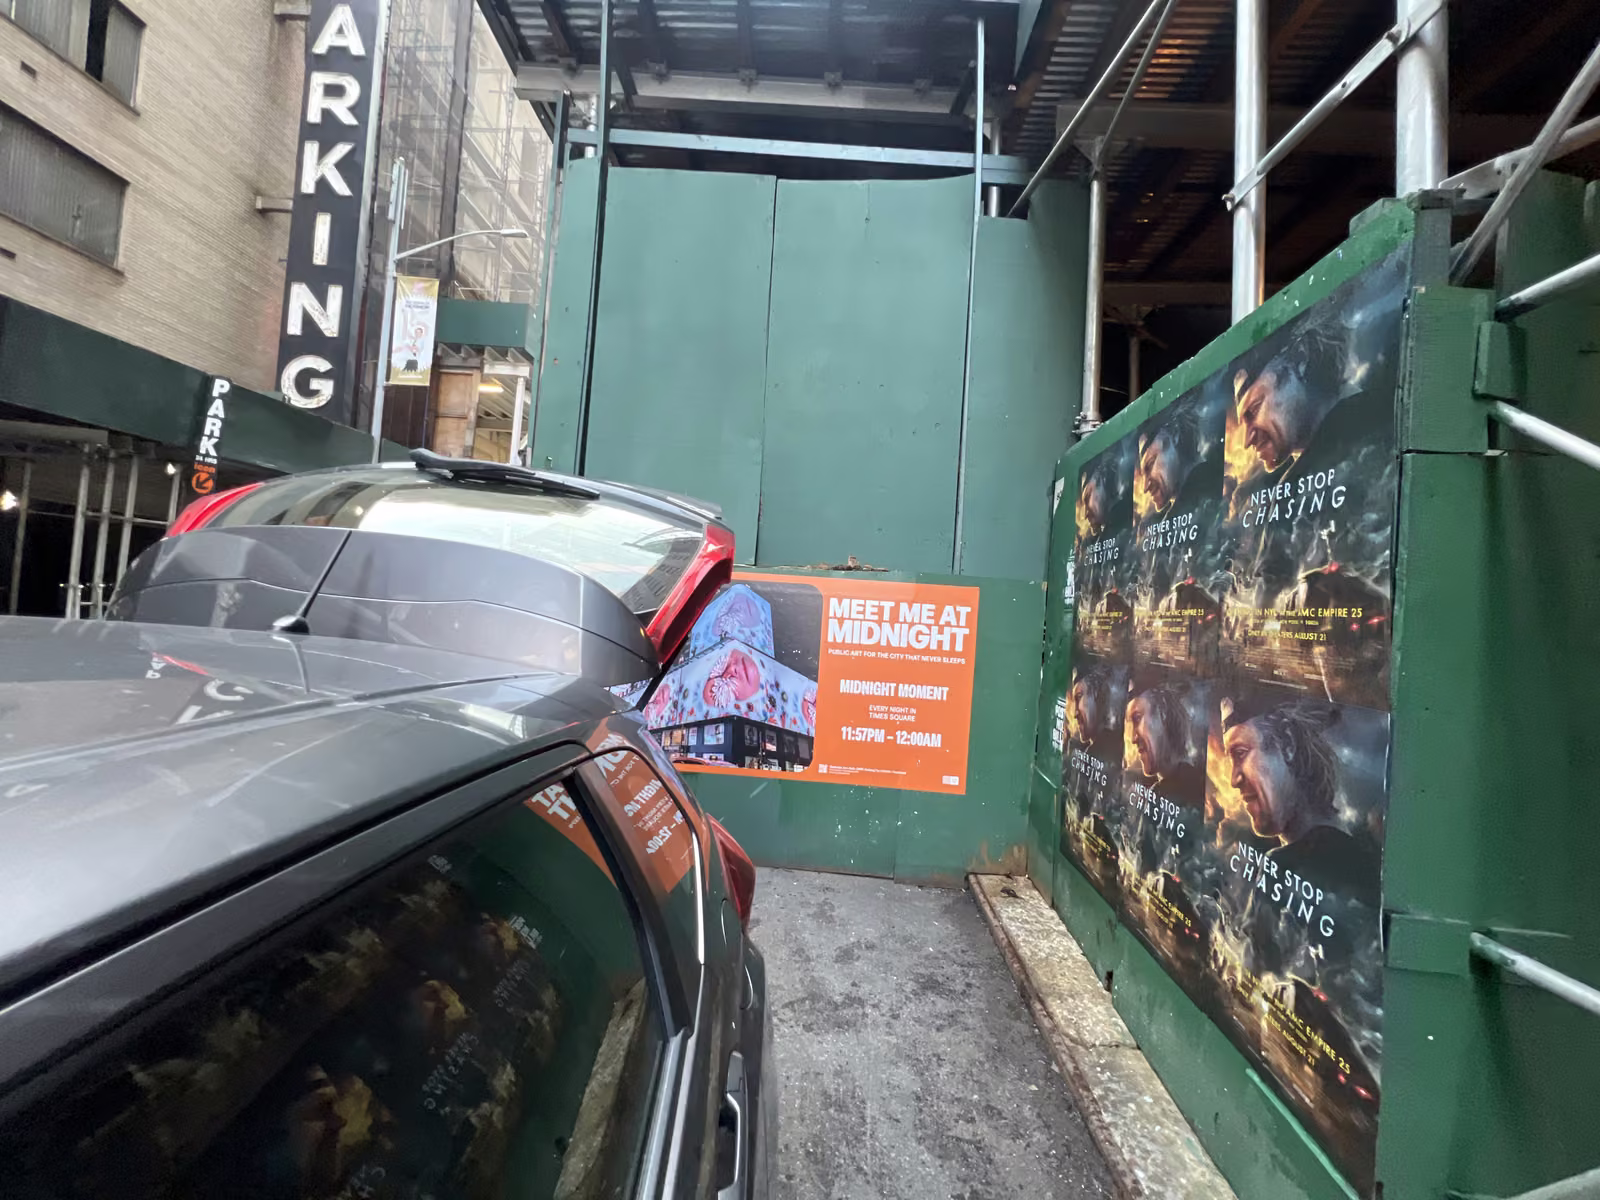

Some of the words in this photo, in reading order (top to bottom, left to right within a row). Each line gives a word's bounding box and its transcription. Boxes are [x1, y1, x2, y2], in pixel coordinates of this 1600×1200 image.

[280, 2, 367, 409] ARKING
[199, 378, 231, 457] PARK
[1250, 482, 1291, 507] NEVER
[1298, 468, 1335, 494] STOP
[1242, 485, 1347, 528] CHASING
[1142, 525, 1199, 552] CHASING
[1147, 519, 1170, 536] NEVER
[1172, 512, 1193, 529] STOP
[1083, 547, 1119, 566] CHASING
[1103, 537, 1116, 550] STOP
[829, 597, 895, 621] MEET
[899, 602, 936, 625] ME
[939, 605, 972, 627] AT
[1297, 607, 1316, 617] AMC
[1317, 607, 1348, 618] EMPIRE
[1351, 607, 1363, 618] 25
[828, 618, 970, 652] MIDNIGHT
[828, 648, 850, 656] PUBLIC
[850, 649, 863, 657] ART
[877, 651, 889, 659] THE
[889, 652, 904, 660] CITY
[905, 653, 921, 661] THAT
[921, 655, 942, 663] NEVER
[943, 656, 966, 665] SLEEPS
[840, 679, 896, 697] MIDNIGHT
[898, 683, 949, 701] MOMENT
[869, 704, 889, 713] EVERY
[889, 705, 909, 714] NIGHT
[910, 707, 917, 715] IN
[869, 711, 889, 721] TIMES
[889, 713, 916, 722] SQUARE
[841, 726, 885, 743] 11:57PM
[895, 730, 942, 747] 12:00AM
[1071, 757, 1108, 786] CHASING
[1074, 747, 1090, 765] NEVER
[1090, 757, 1105, 771] STOP
[1135, 781, 1157, 805] NEVER
[1160, 796, 1181, 818] STOP
[1129, 792, 1186, 838] CHASING
[1238, 840, 1279, 879] NEVER
[1284, 869, 1324, 906] STOP
[1230, 854, 1335, 937] CHASING
[1306, 1025, 1337, 1061] EMPIRE
[1338, 1057, 1352, 1075] 25
